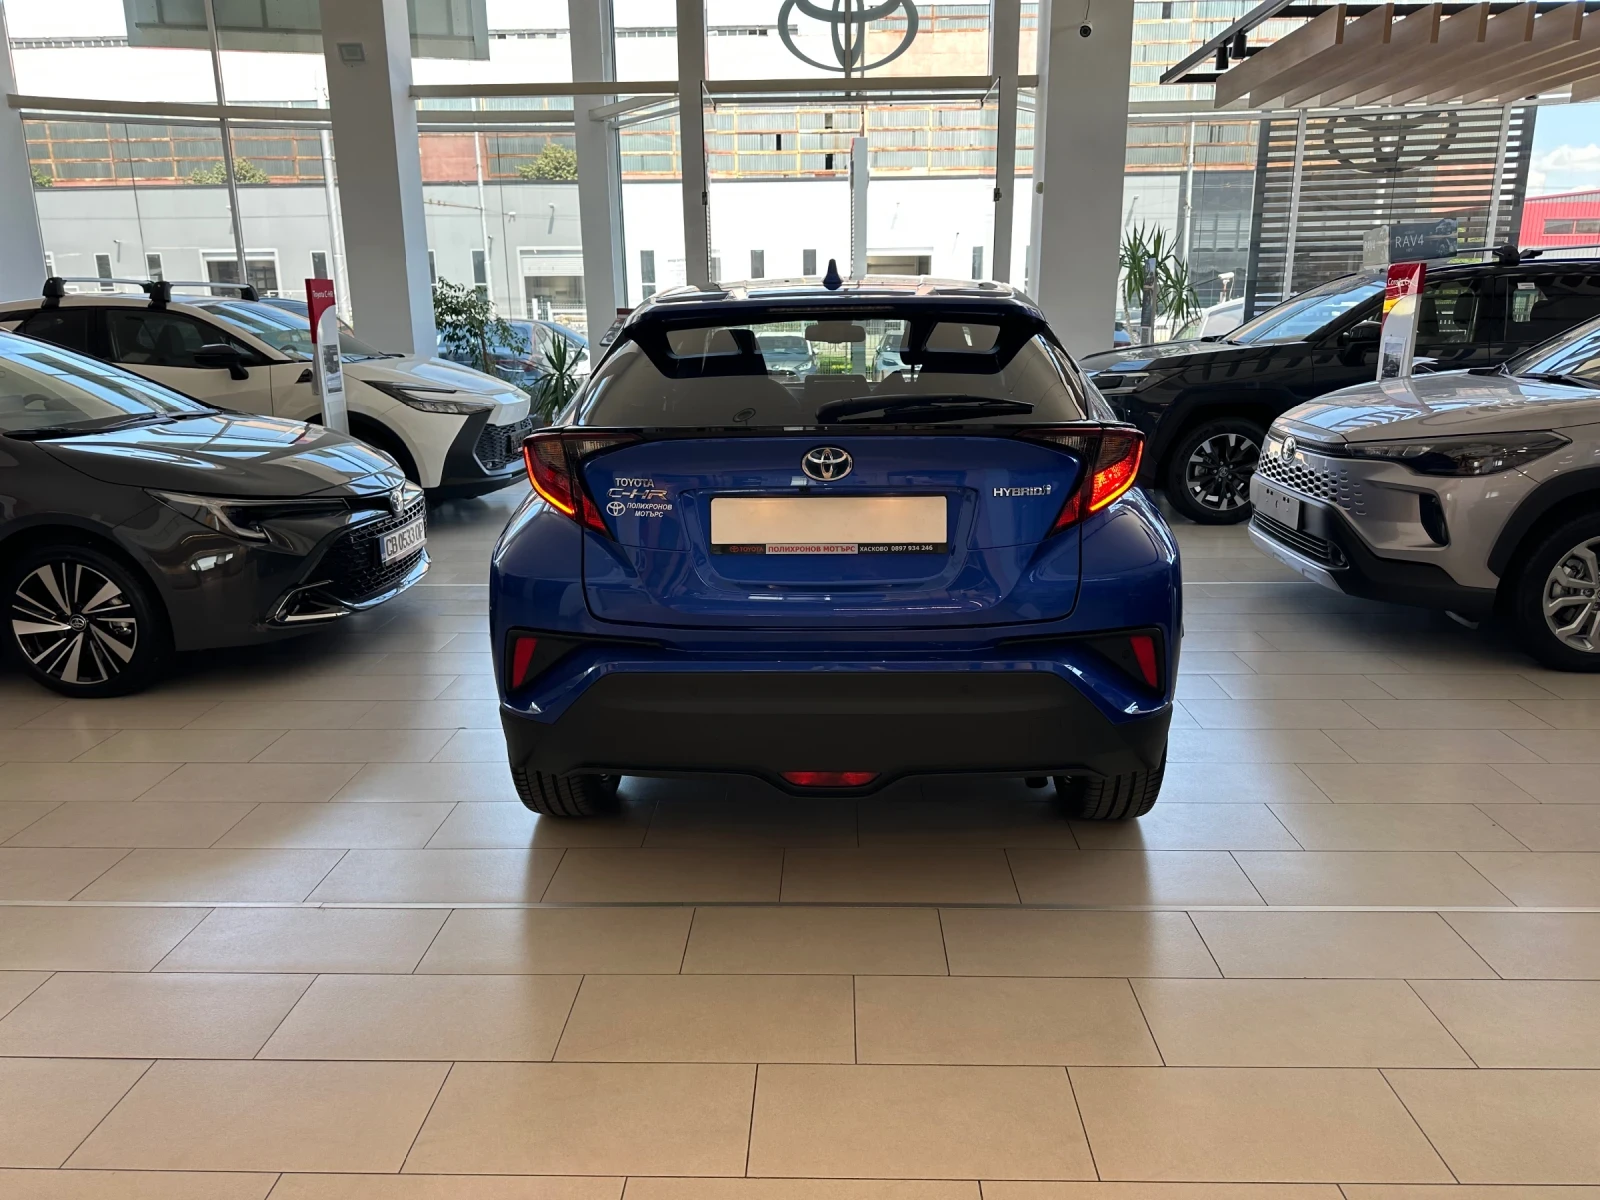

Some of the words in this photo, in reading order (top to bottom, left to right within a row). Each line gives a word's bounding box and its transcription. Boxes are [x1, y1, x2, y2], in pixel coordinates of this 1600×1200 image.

[1395, 234, 1425, 248] RAV4
[312, 290, 324, 299] Toyota
[615, 478, 654, 487] TOYOTA
[607, 488, 668, 500] C-HR
[993, 487, 1042, 497] HYBRID
[626, 502, 673, 511] ПОЛИХРОНОВ
[634, 510, 664, 518] МОТЪРС
[386, 536, 398, 556] CB
[398, 527, 416, 550] 0533
[768, 545, 821, 553] ПОЛИХРОНОВ
[823, 545, 856, 553] МОТЪРС
